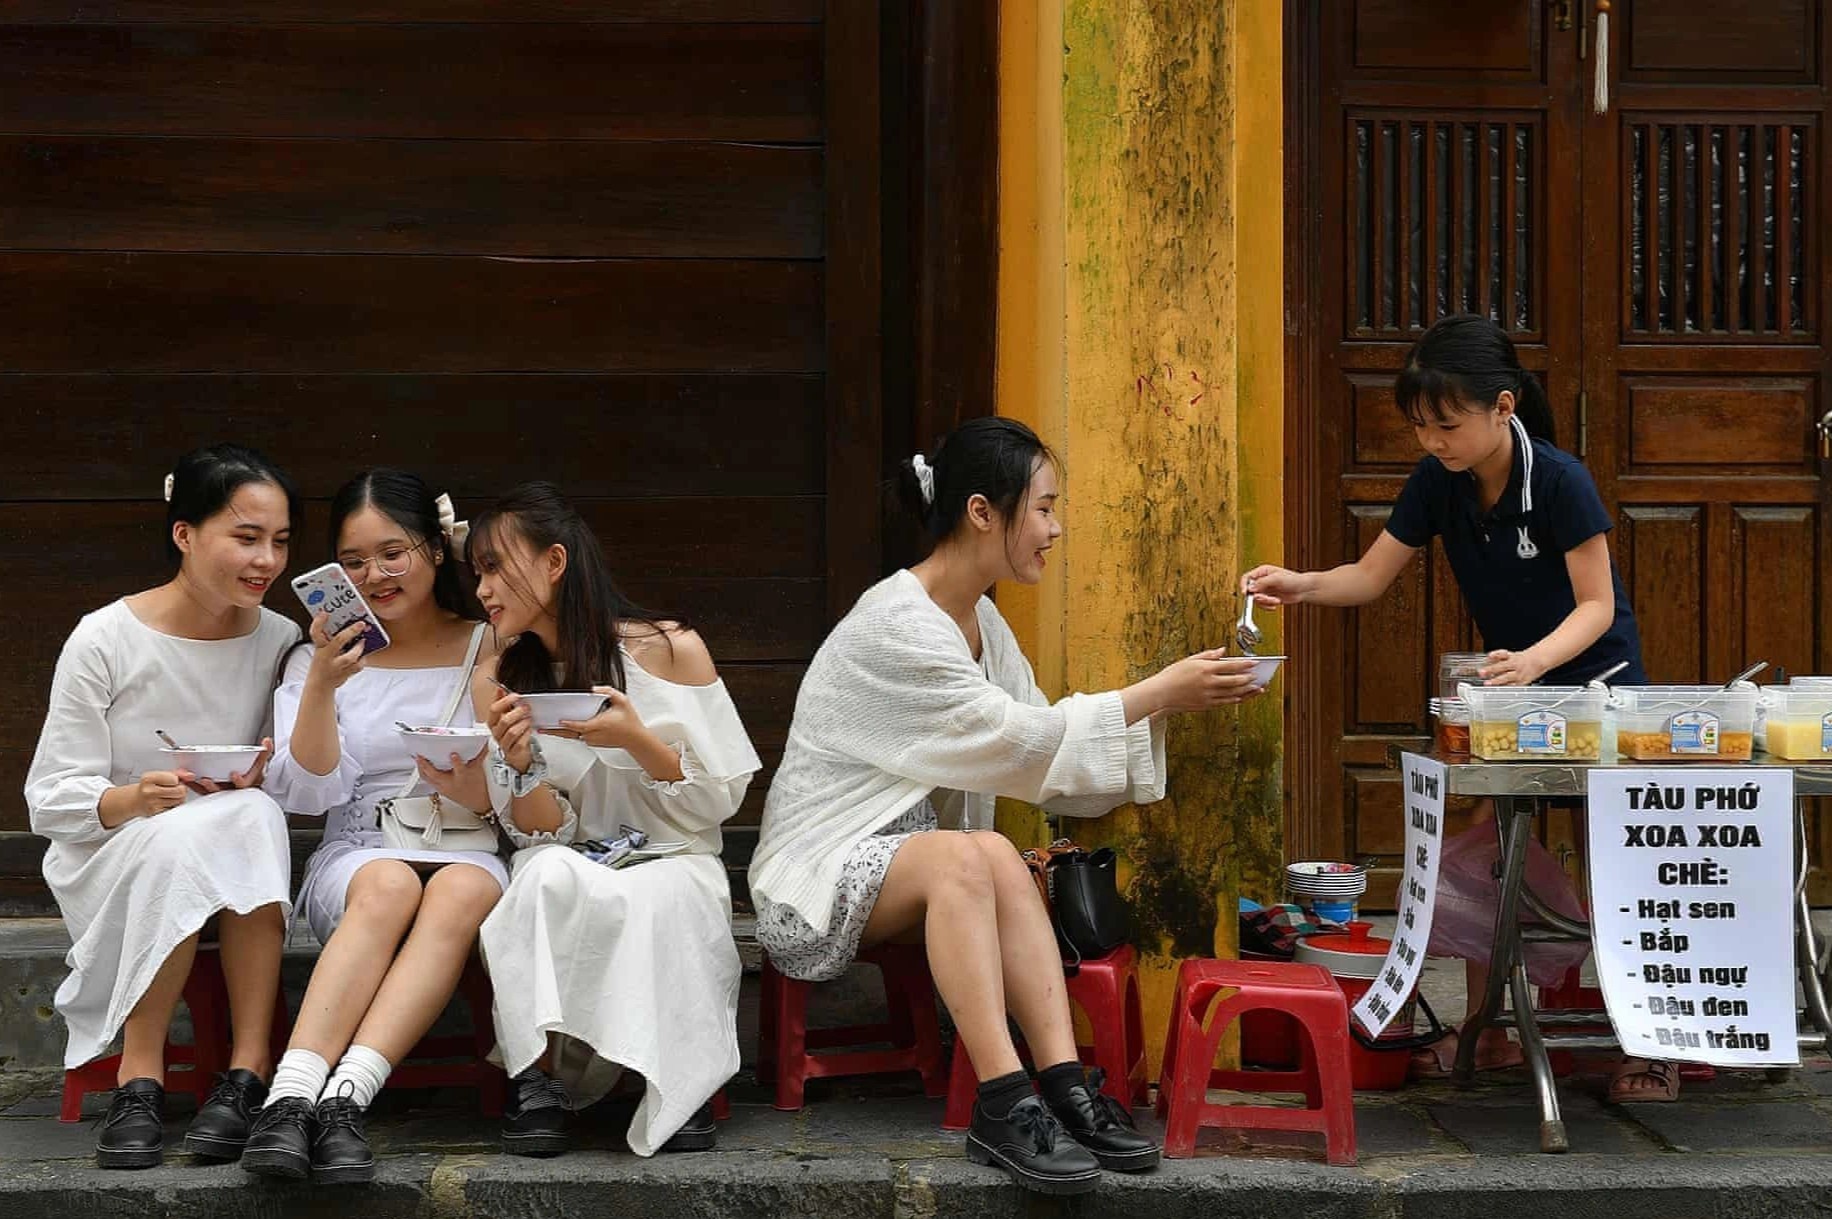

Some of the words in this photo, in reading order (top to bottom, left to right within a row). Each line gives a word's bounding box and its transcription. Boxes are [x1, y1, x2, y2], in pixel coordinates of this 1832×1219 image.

[1625, 782, 1685, 810] TÀU
[1695, 782, 1760, 810] PHỚ
[1624, 825, 1688, 847] XOA
[1697, 825, 1761, 847] XOA
[1658, 858, 1728, 885] CHÈ:
[1638, 900, 1681, 923] Hạt
[1689, 902, 1736, 918] sen
[1640, 928, 1689, 953] Bắp
[1643, 964, 1691, 988] Đậu
[1699, 966, 1748, 988] ngự
[1648, 996, 1695, 1020] Đậu
[1702, 997, 1748, 1016] đen
[1655, 1028, 1700, 1050] Đậu
[1706, 1025, 1770, 1051] trắng
